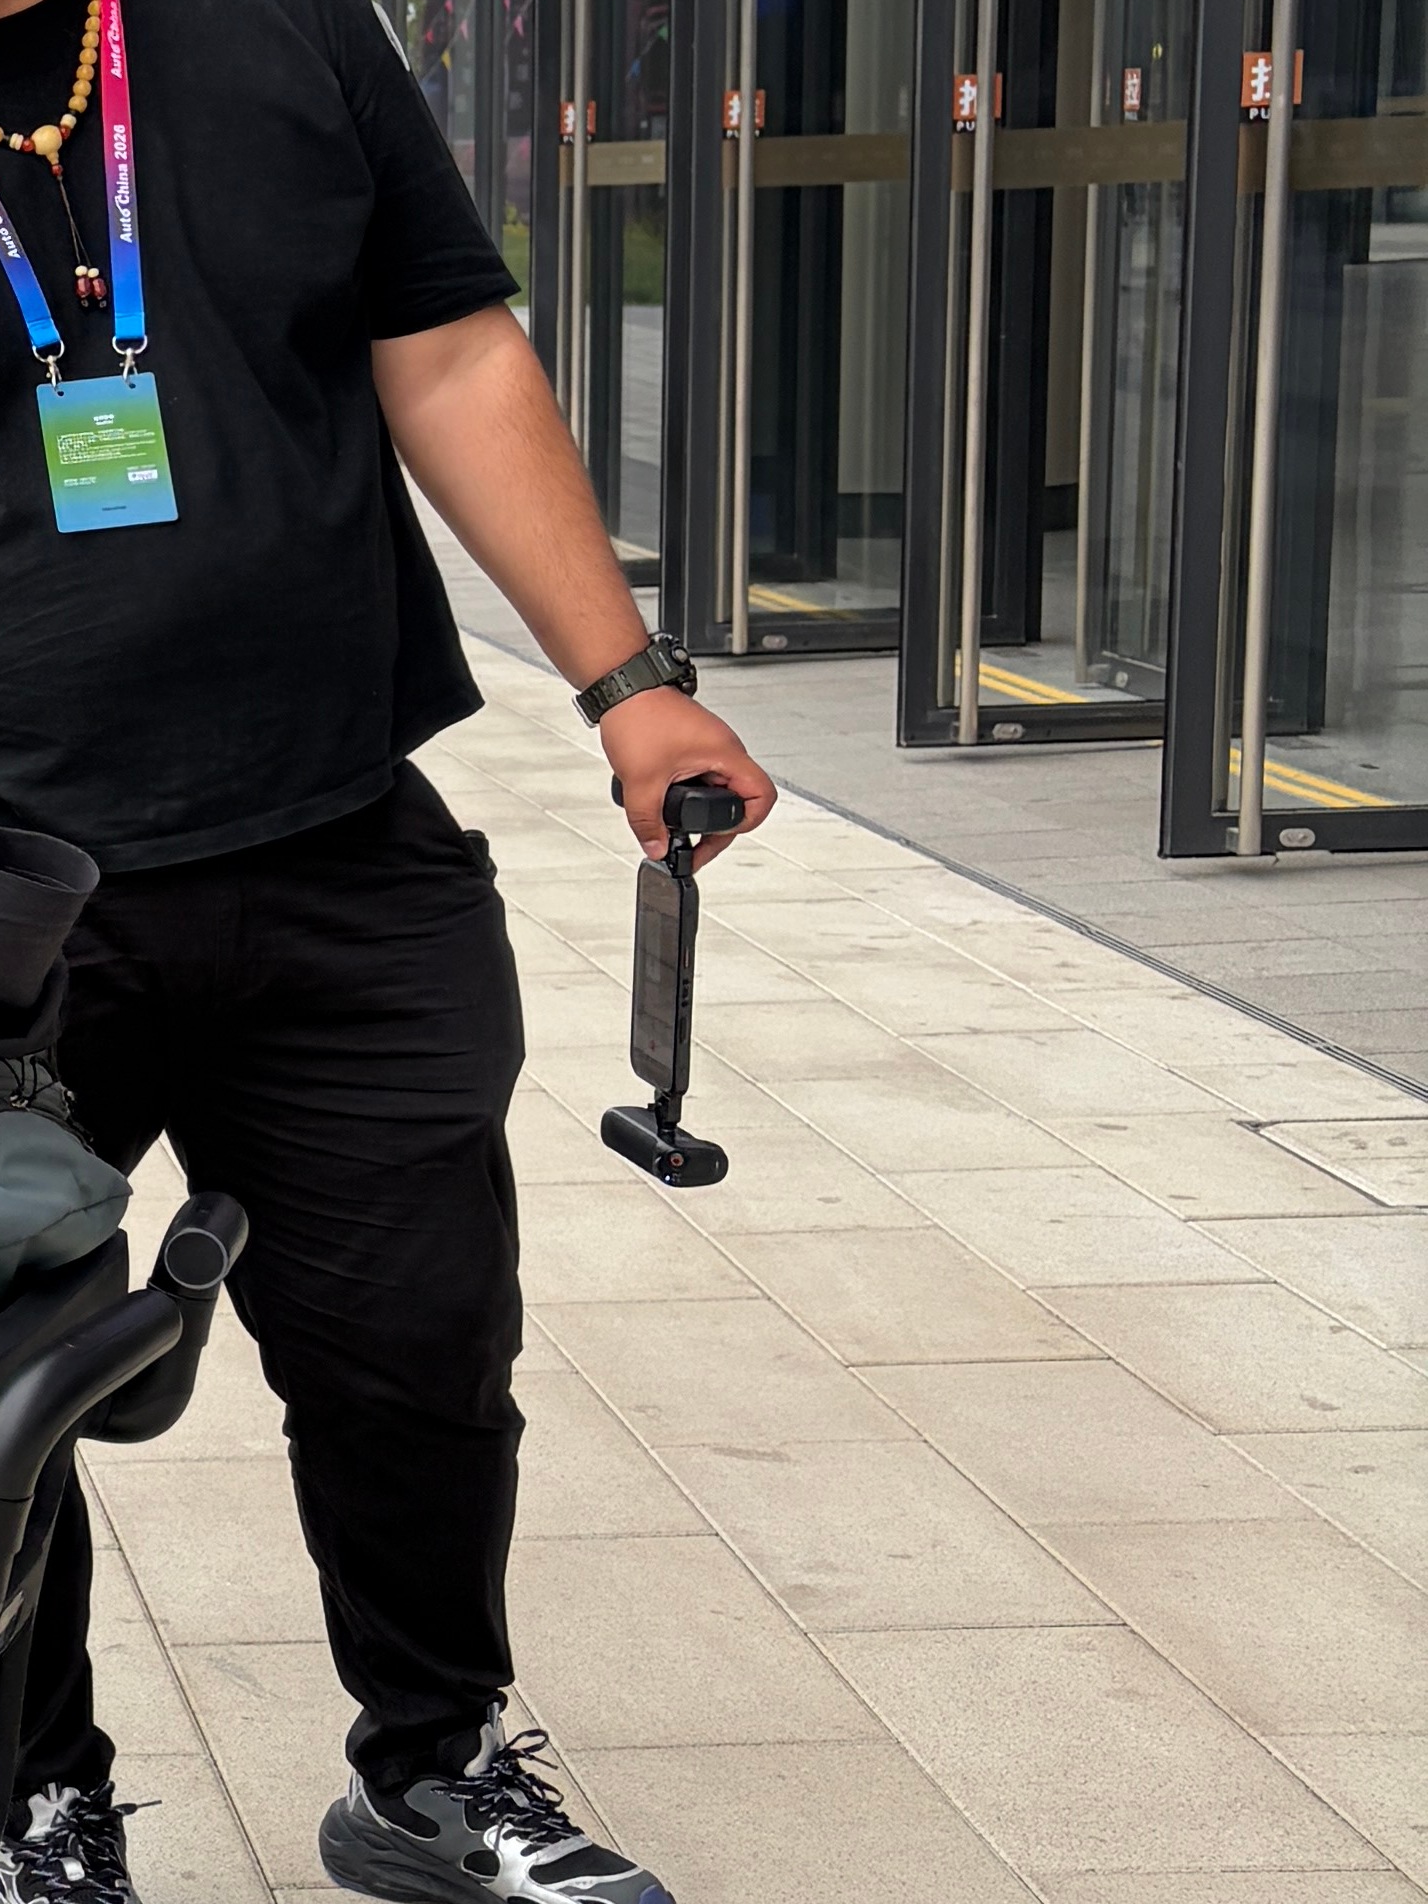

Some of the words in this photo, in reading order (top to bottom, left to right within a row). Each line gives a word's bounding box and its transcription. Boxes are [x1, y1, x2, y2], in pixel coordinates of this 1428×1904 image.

[1249, 107, 1271, 121] PU
[113, 124, 128, 161] 2026
[114, 163, 130, 205] China
[118, 207, 133, 244] Auto
